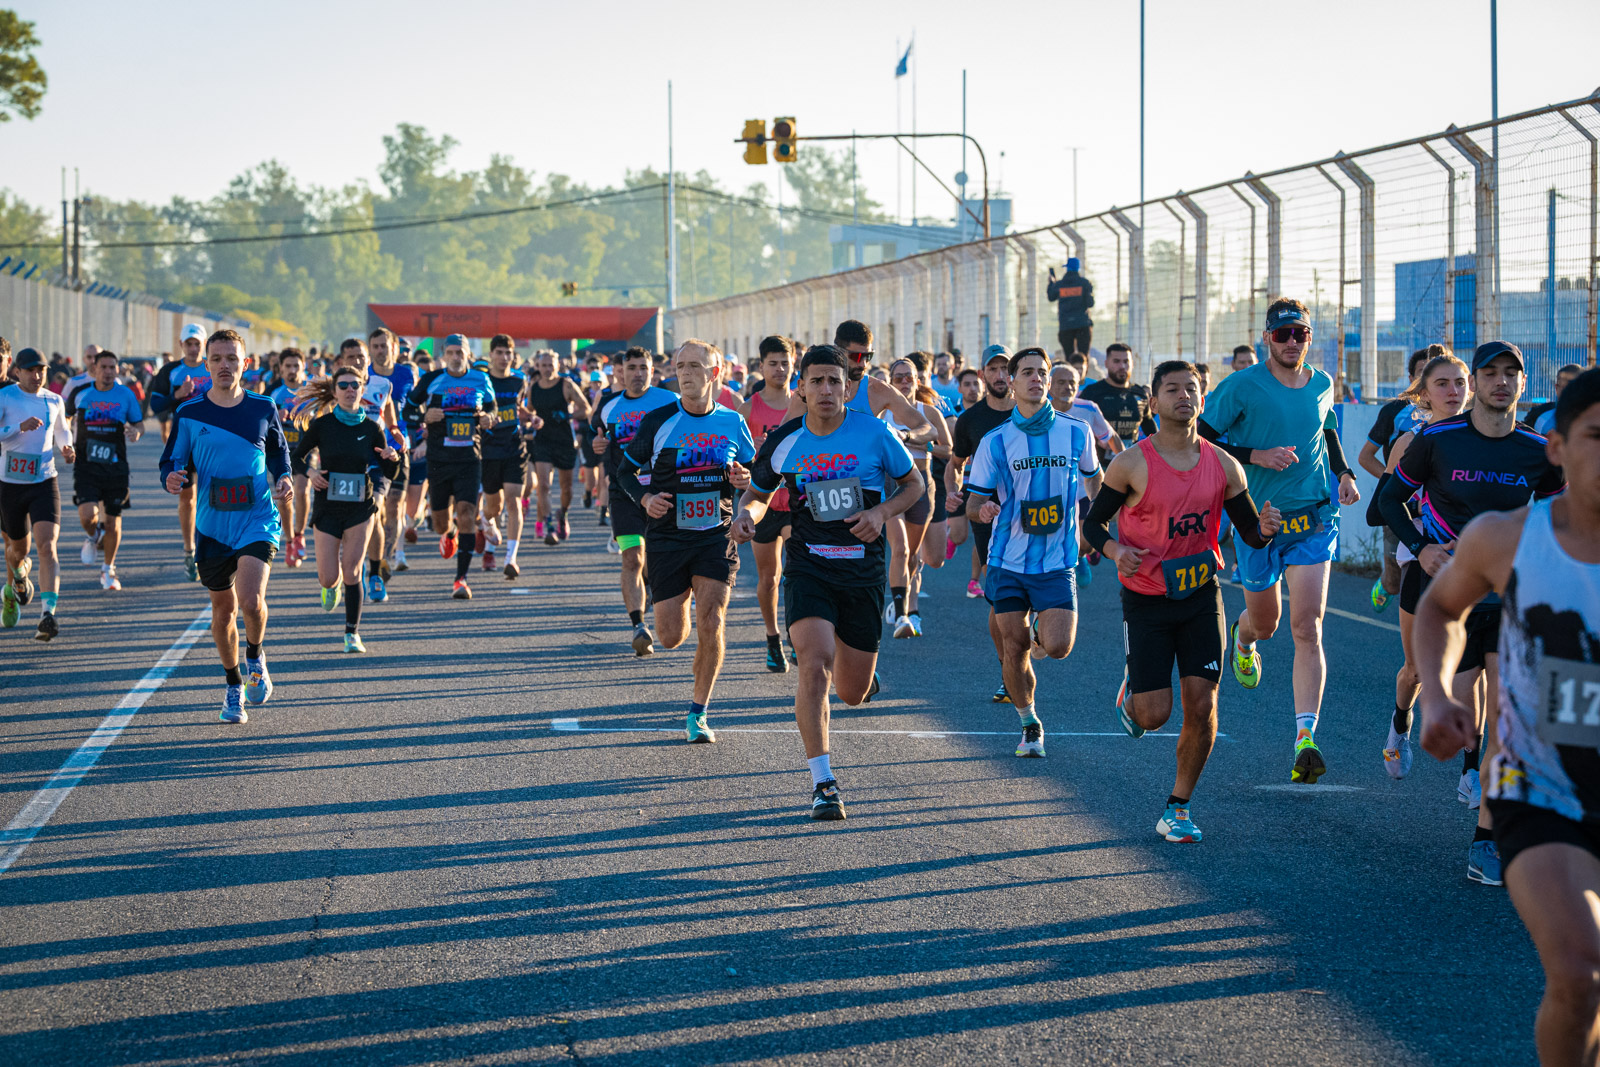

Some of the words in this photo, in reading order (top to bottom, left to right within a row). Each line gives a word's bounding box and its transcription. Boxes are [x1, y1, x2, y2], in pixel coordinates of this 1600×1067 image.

[452, 423, 470, 436] 797
[91, 445, 110, 459] 140
[11, 458, 35, 475] 374
[1013, 455, 1067, 471] GUEPARD
[339, 480, 354, 496] 21
[1451, 469, 1529, 488] RUNNEA
[219, 484, 248, 504] 312
[818, 487, 853, 512] 105
[686, 499, 714, 519] 359
[1028, 504, 1058, 526] 705
[1175, 563, 1209, 591] 712
